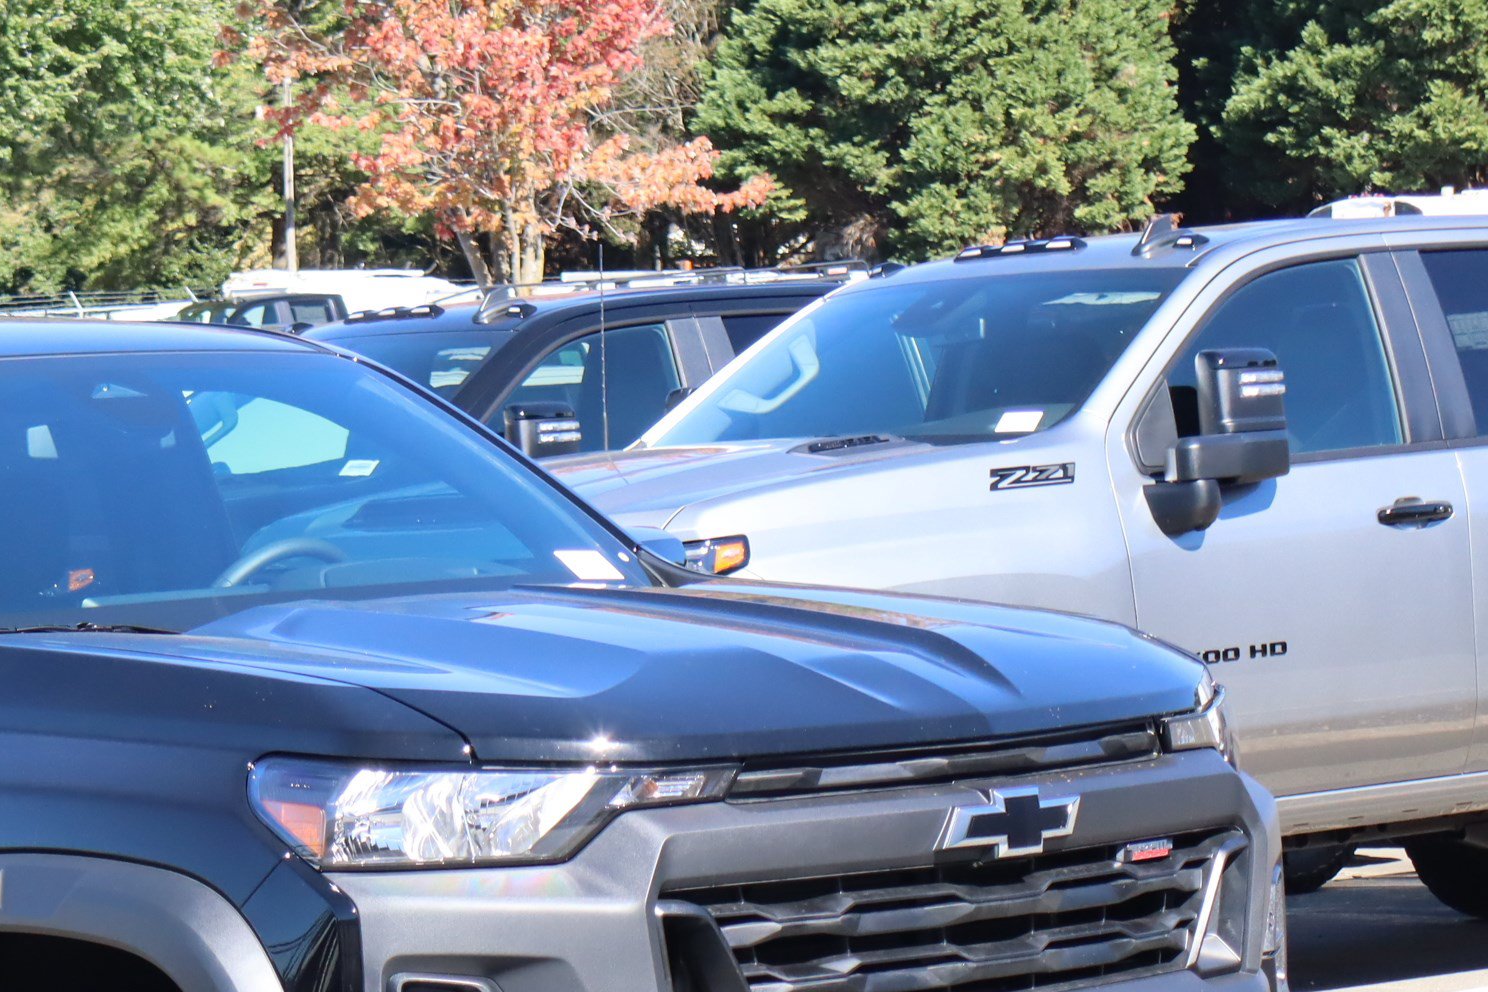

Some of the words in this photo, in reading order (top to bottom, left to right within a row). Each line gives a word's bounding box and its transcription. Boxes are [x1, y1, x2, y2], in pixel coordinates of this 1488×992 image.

[990, 462, 1075, 491] Z71
[1197, 647, 1240, 665] 00
[1250, 641, 1287, 659] HD
